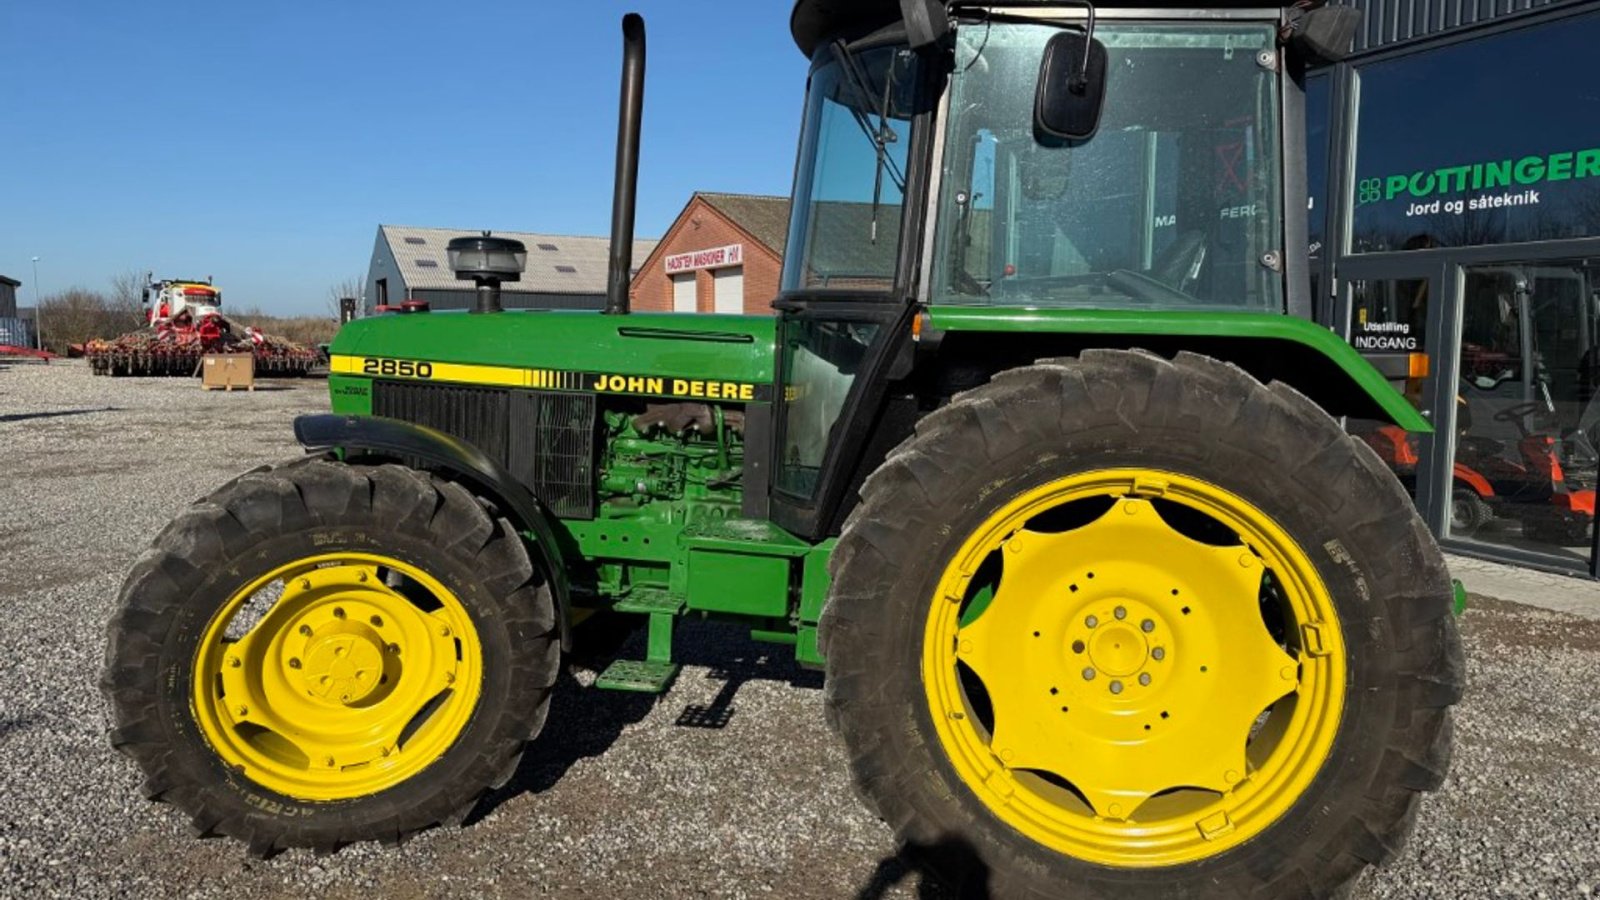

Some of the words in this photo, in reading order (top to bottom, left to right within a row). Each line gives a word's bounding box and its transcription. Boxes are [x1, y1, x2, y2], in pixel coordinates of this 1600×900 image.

[1406, 200, 1440, 216] Jord
[1444, 199, 1464, 214] og
[1363, 321, 1410, 334] Udstilling
[1355, 336, 1417, 349] INDGANG
[363, 358, 433, 379] 2850
[593, 374, 664, 395] JOHN
[672, 379, 755, 401] DEERE
